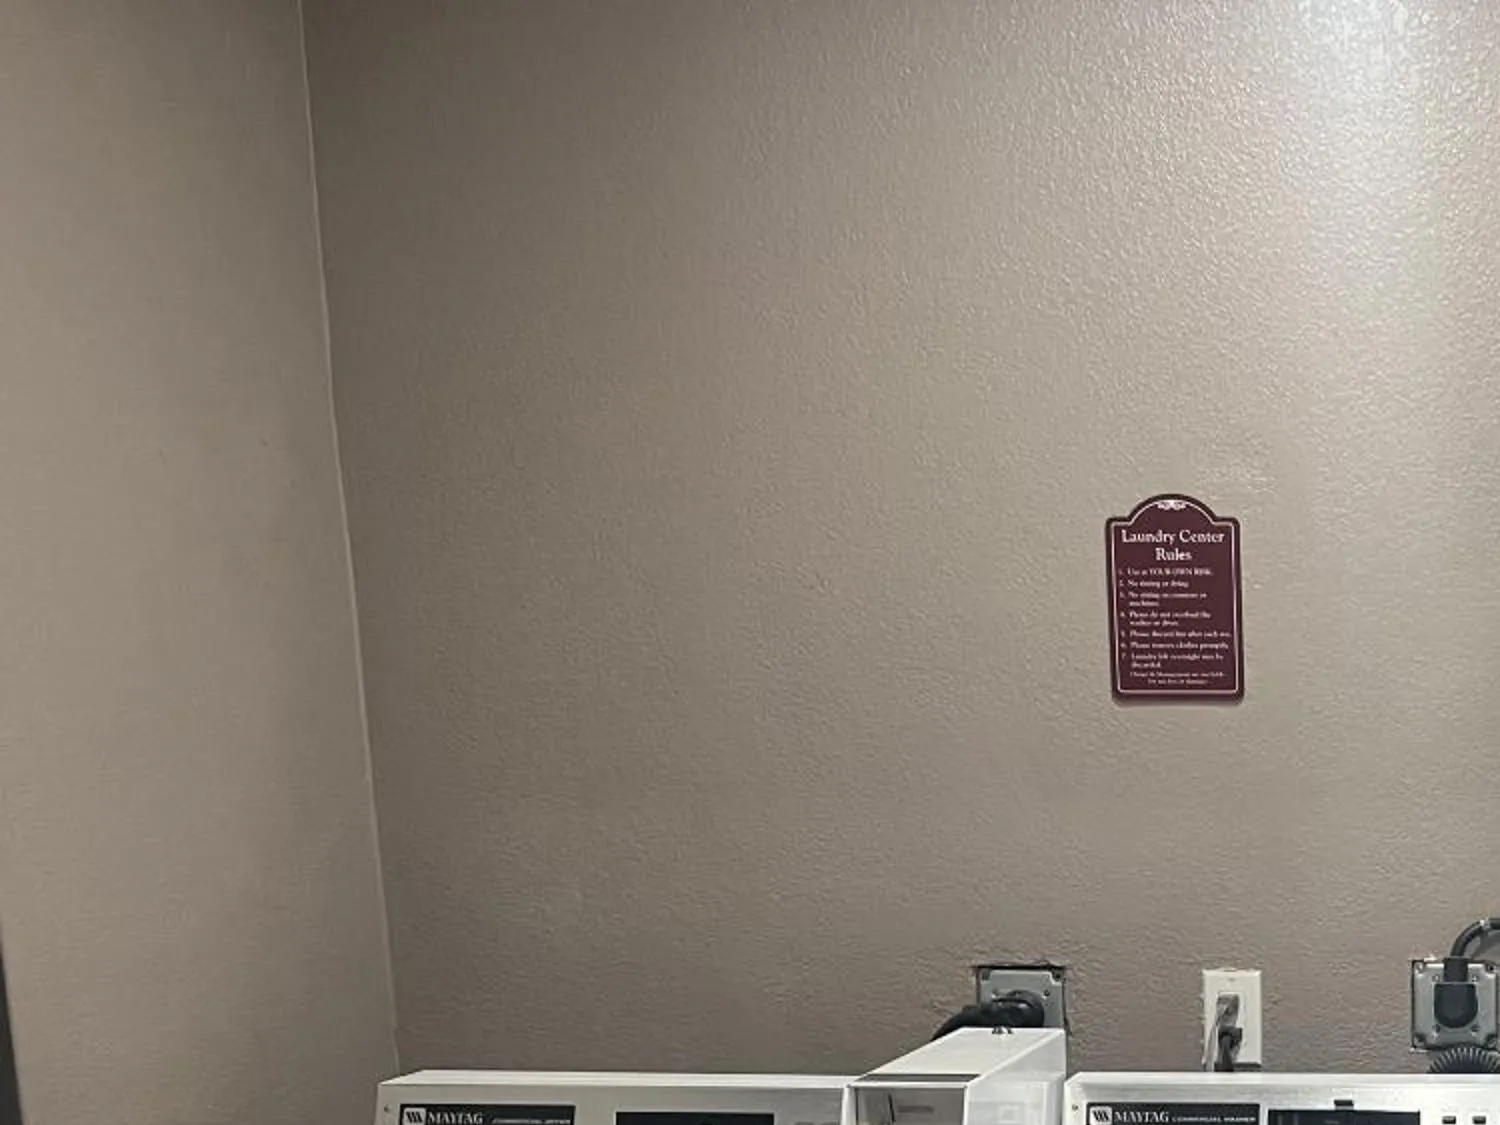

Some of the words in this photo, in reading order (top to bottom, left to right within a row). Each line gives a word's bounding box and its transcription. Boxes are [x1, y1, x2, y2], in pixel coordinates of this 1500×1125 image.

[1121, 529, 1176, 545] Laundry
[1179, 529, 1225, 543] Center
[1156, 547, 1193, 561] Rules
[1128, 579, 1138, 588] No
[427, 1111, 484, 1125] MAYTAG
[1114, 1111, 1170, 1124] MAYTAG
